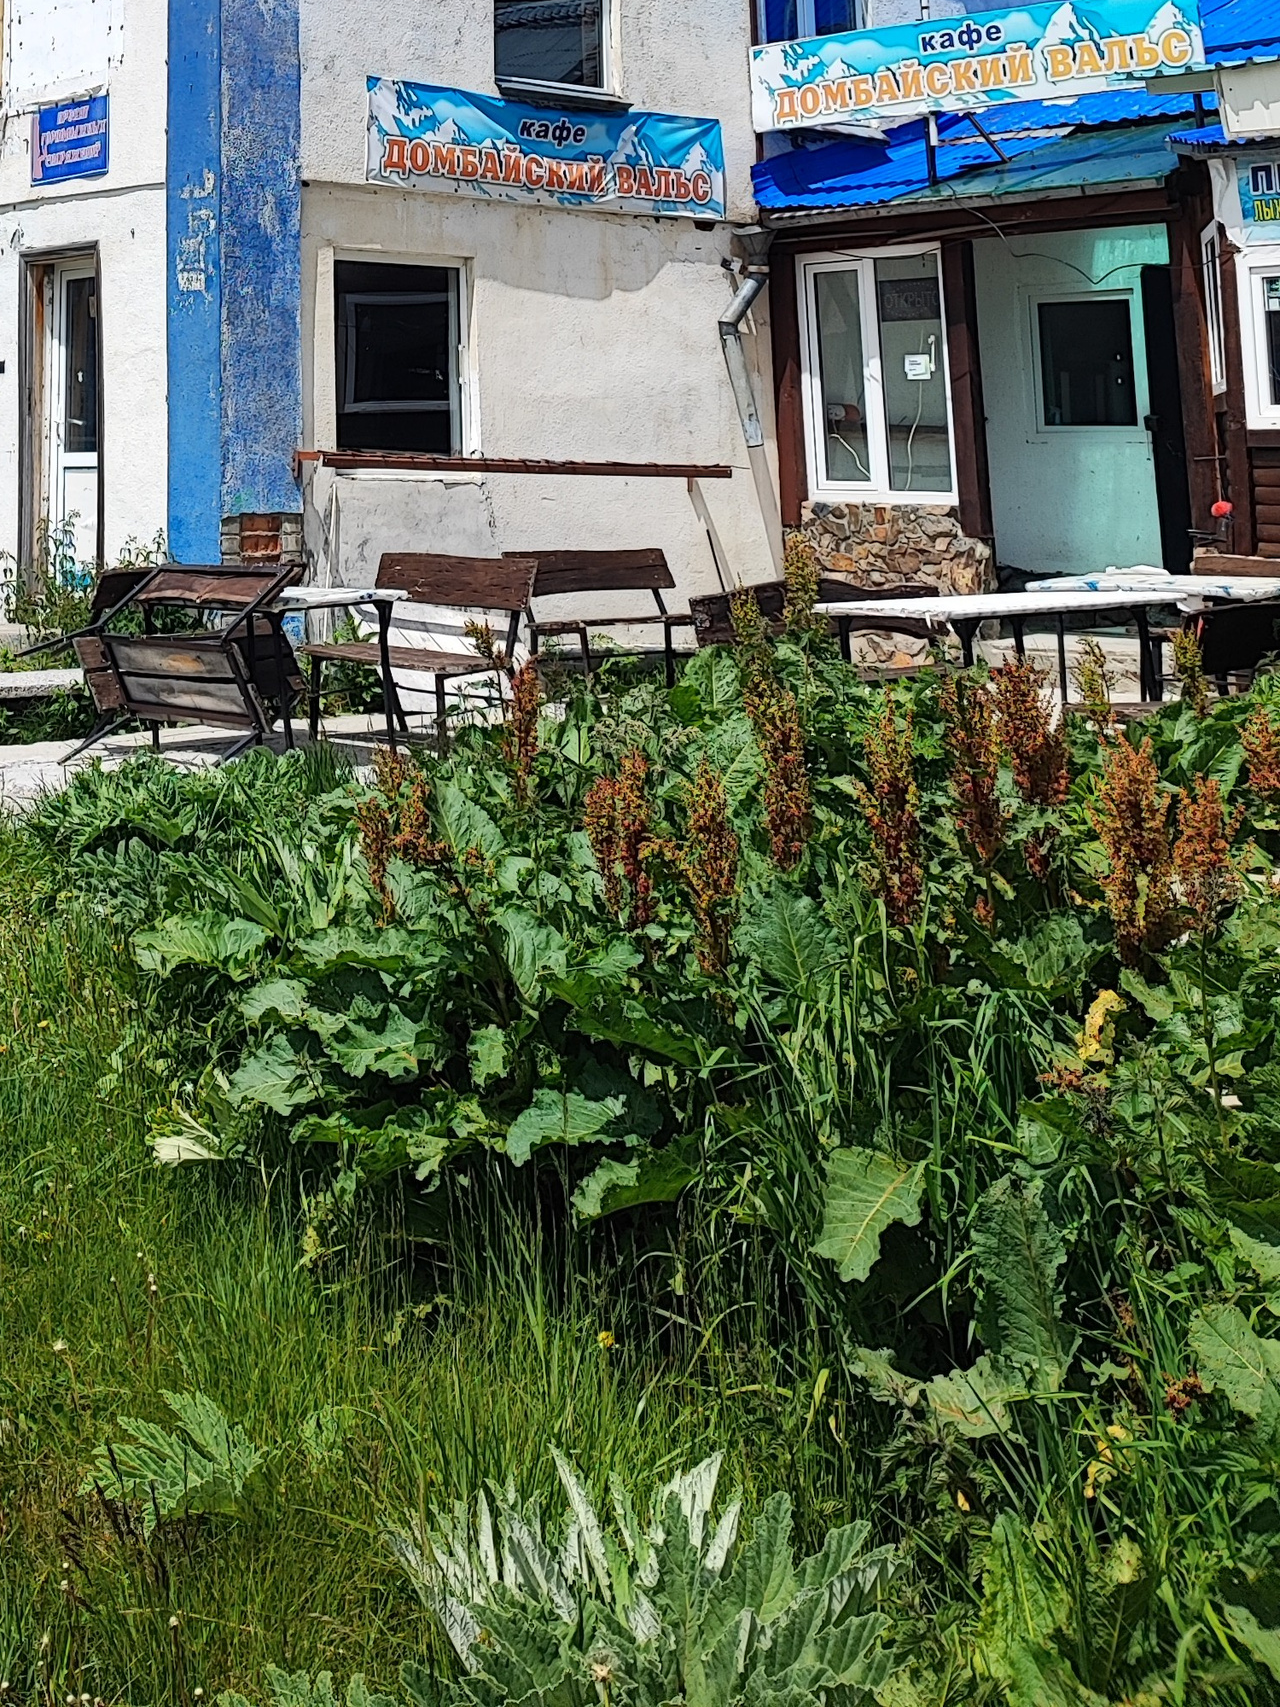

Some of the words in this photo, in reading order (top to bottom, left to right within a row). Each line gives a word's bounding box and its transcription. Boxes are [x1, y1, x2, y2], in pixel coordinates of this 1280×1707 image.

[921, 23, 1002, 53] кафе
[776, 46, 1034, 125] ДОМБАЙСКИЙ
[1047, 30, 1192, 80] ВАЛЬС
[519, 119, 586, 147] кафе
[383, 136, 607, 194] ДОМБАЙСКИЙ
[615, 164, 712, 202] ВАЛЬС
